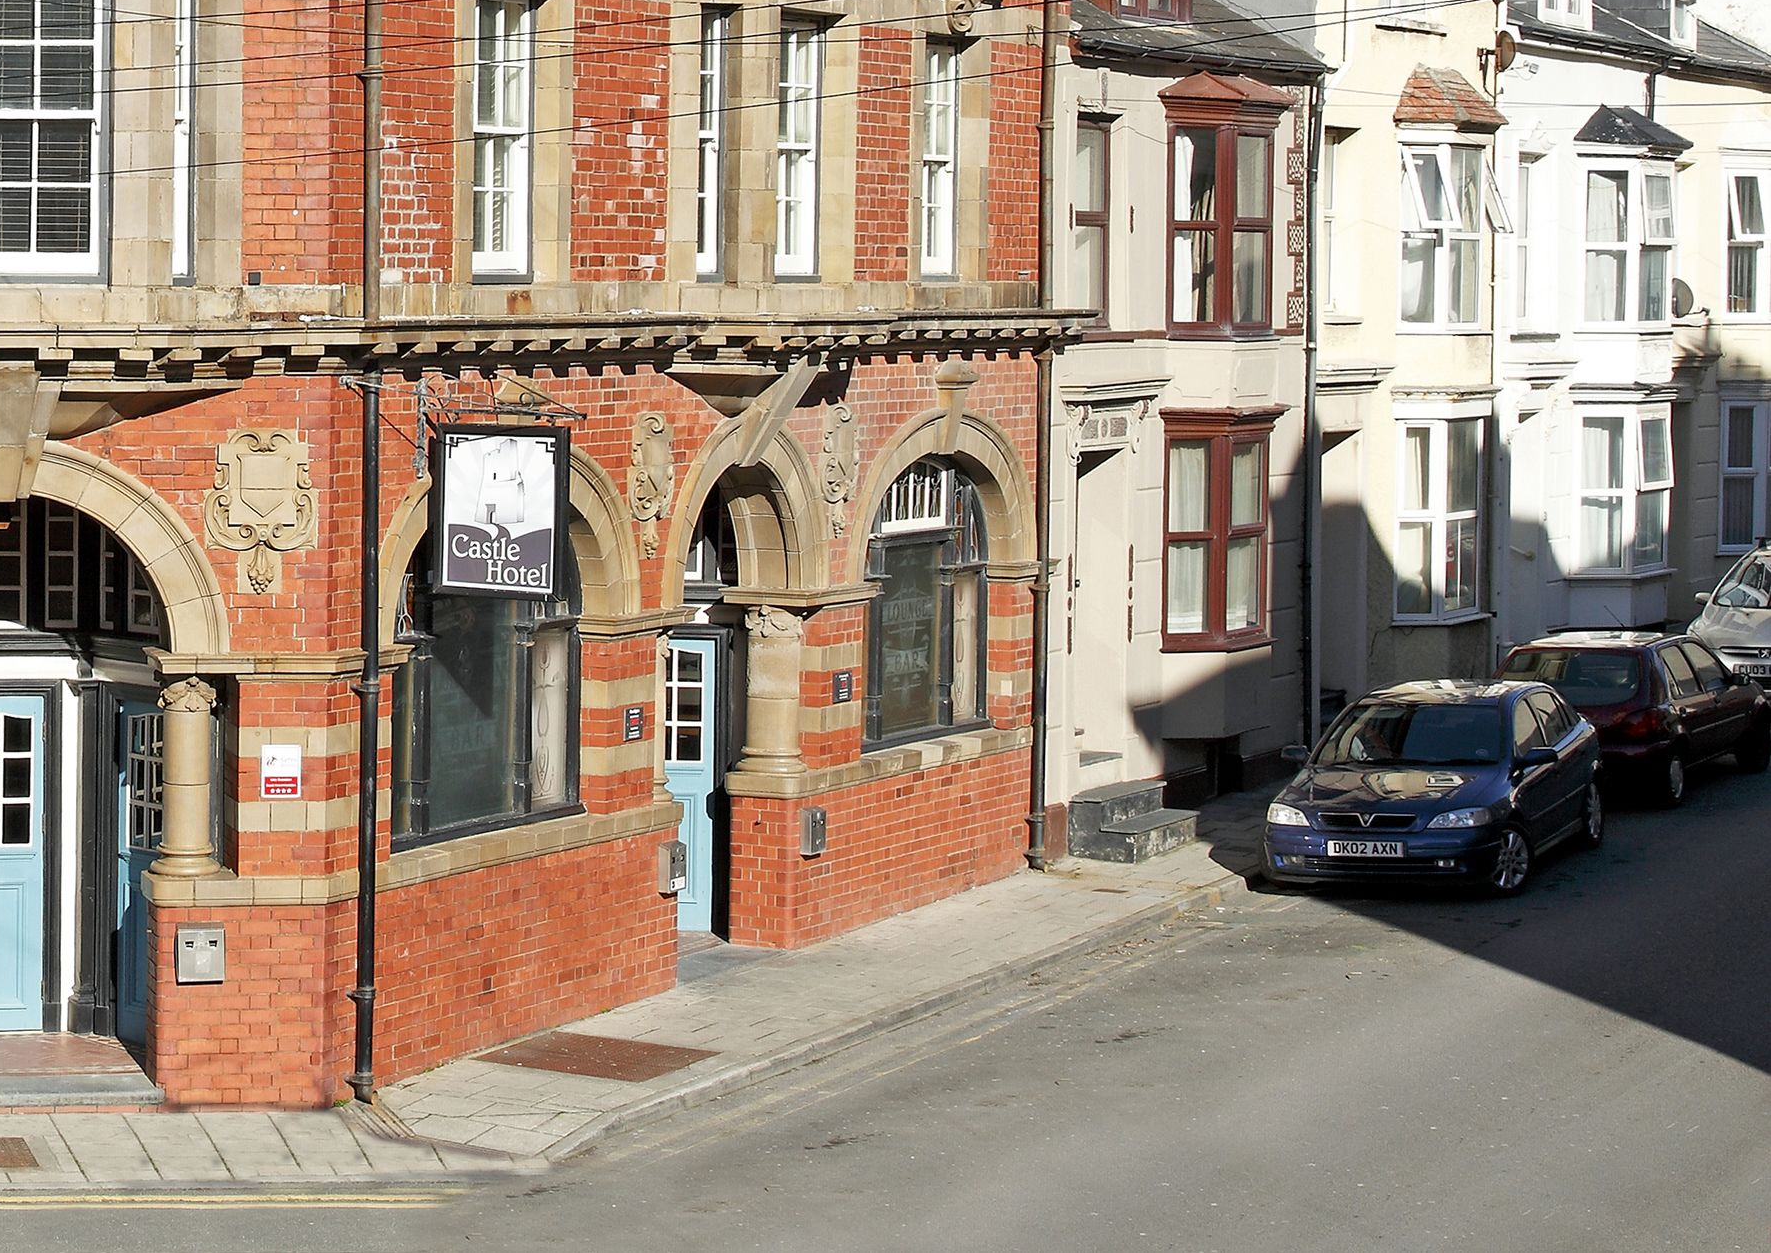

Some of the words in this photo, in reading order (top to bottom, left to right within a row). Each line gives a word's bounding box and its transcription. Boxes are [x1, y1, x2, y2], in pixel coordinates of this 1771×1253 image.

[451, 533, 521, 562] Castle
[485, 559, 548, 587] Hotel
[888, 599, 928, 621] LOUNGE
[895, 650, 919, 671] BAR
[1333, 842, 1368, 855] DK02
[1371, 842, 1398, 855] AXN
